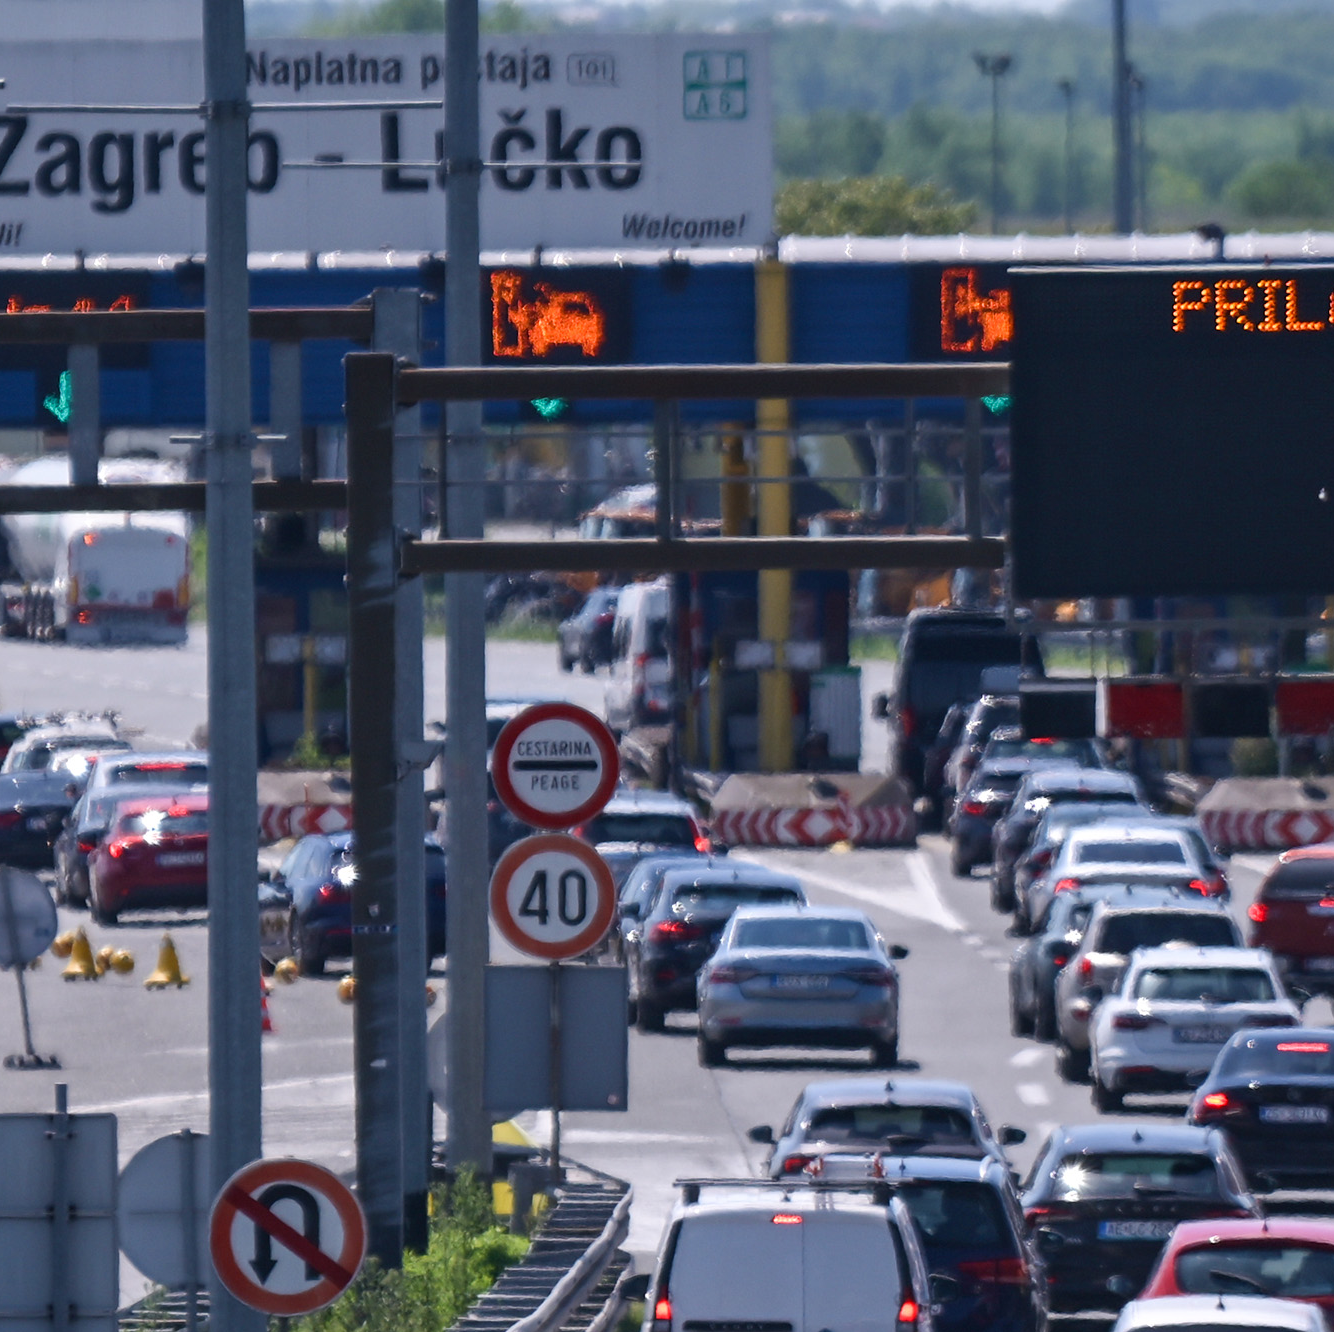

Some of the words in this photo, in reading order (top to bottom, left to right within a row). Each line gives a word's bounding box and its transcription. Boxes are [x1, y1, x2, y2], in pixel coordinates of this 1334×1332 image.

[246, 50, 402, 91] Naplatna
[420, 46, 551, 90] ptaja
[621, 213, 748, 241] Welcome!
[517, 740, 592, 757] CESTARINA
[518, 869, 587, 927] 40
